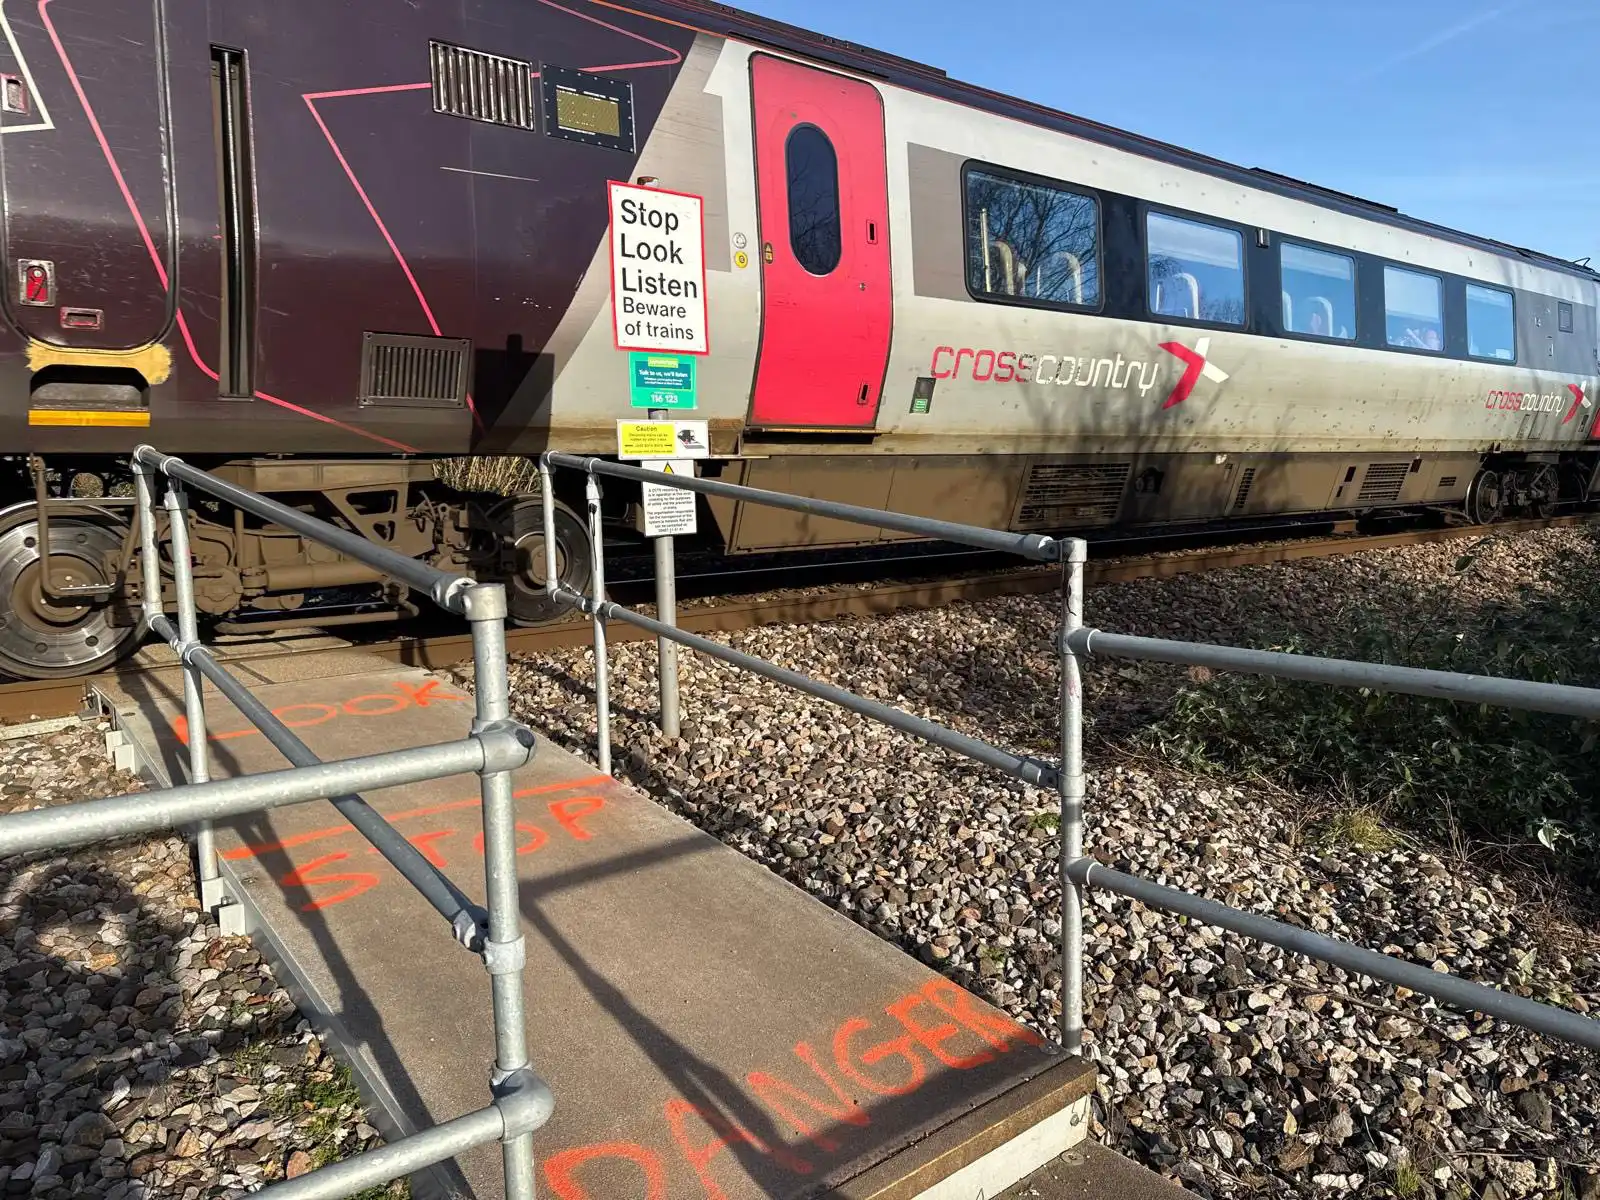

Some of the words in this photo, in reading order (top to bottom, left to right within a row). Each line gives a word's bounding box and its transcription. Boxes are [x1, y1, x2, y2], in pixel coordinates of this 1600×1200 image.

[620, 199, 679, 235] Stop
[620, 233, 684, 264] Look
[622, 267, 697, 298] Listen
[623, 297, 686, 318] Beware
[625, 321, 641, 336] of
[647, 322, 694, 340] trains
[930, 345, 1159, 397] crosscountry
[651, 395, 663, 403] 116
[665, 395, 678, 403] 123
[1485, 390, 1565, 416] crosscountry
[174, 680, 465, 745] LOOK
[281, 796, 605, 911] STOP
